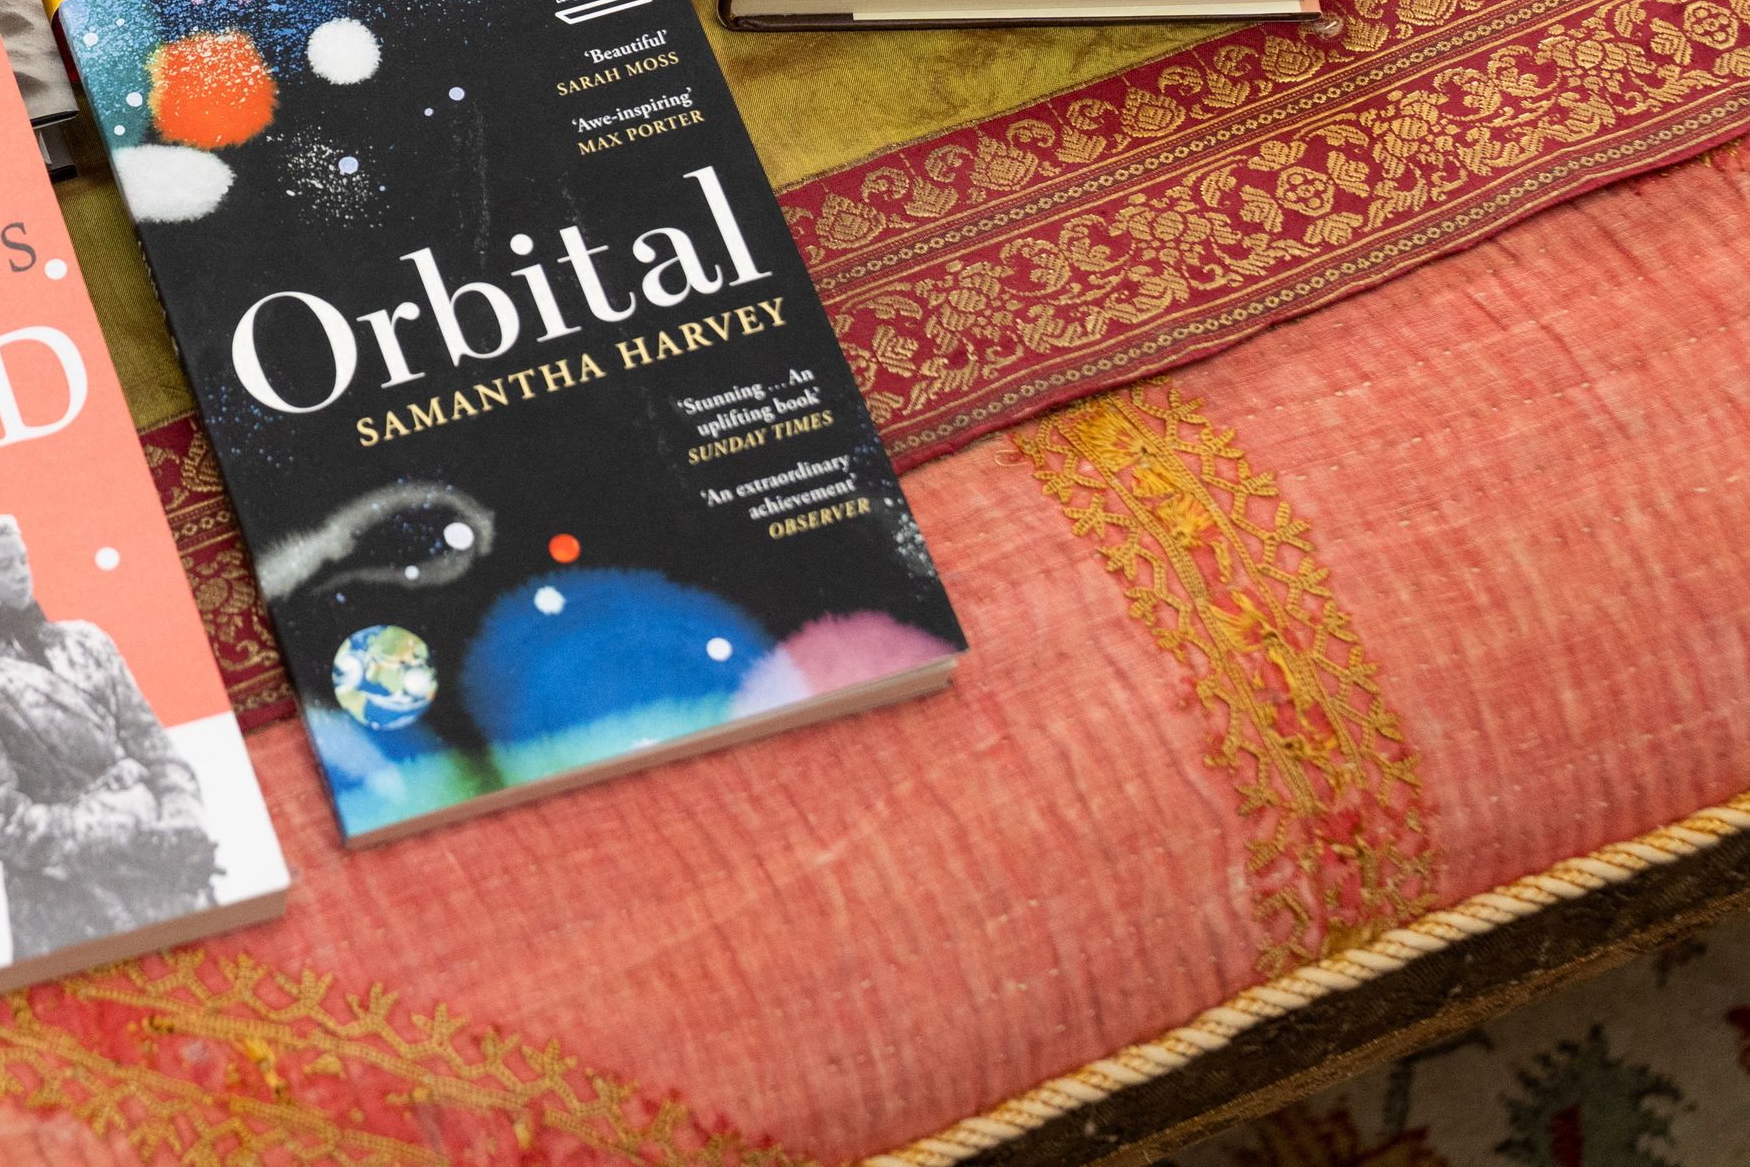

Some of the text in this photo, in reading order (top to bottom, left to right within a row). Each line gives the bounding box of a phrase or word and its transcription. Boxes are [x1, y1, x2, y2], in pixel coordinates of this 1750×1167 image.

[584, 29, 668, 64] ‘Beautiful’
[556, 51, 680, 96] SARAH MOSS
[572, 87, 693, 133] ‘Awe-inspiring’
[577, 109, 706, 156] MAX PORTER
[231, 165, 773, 414] Orbital
[356, 296, 787, 448] SAMANTHA HARVEY
[788, 368, 815, 386] An
[688, 410, 835, 466] SUNDAY TIMES
[697, 404, 775, 439] uplifting
[736, 454, 851, 497] extraordinary
[768, 497, 872, 540] OBSERVER
